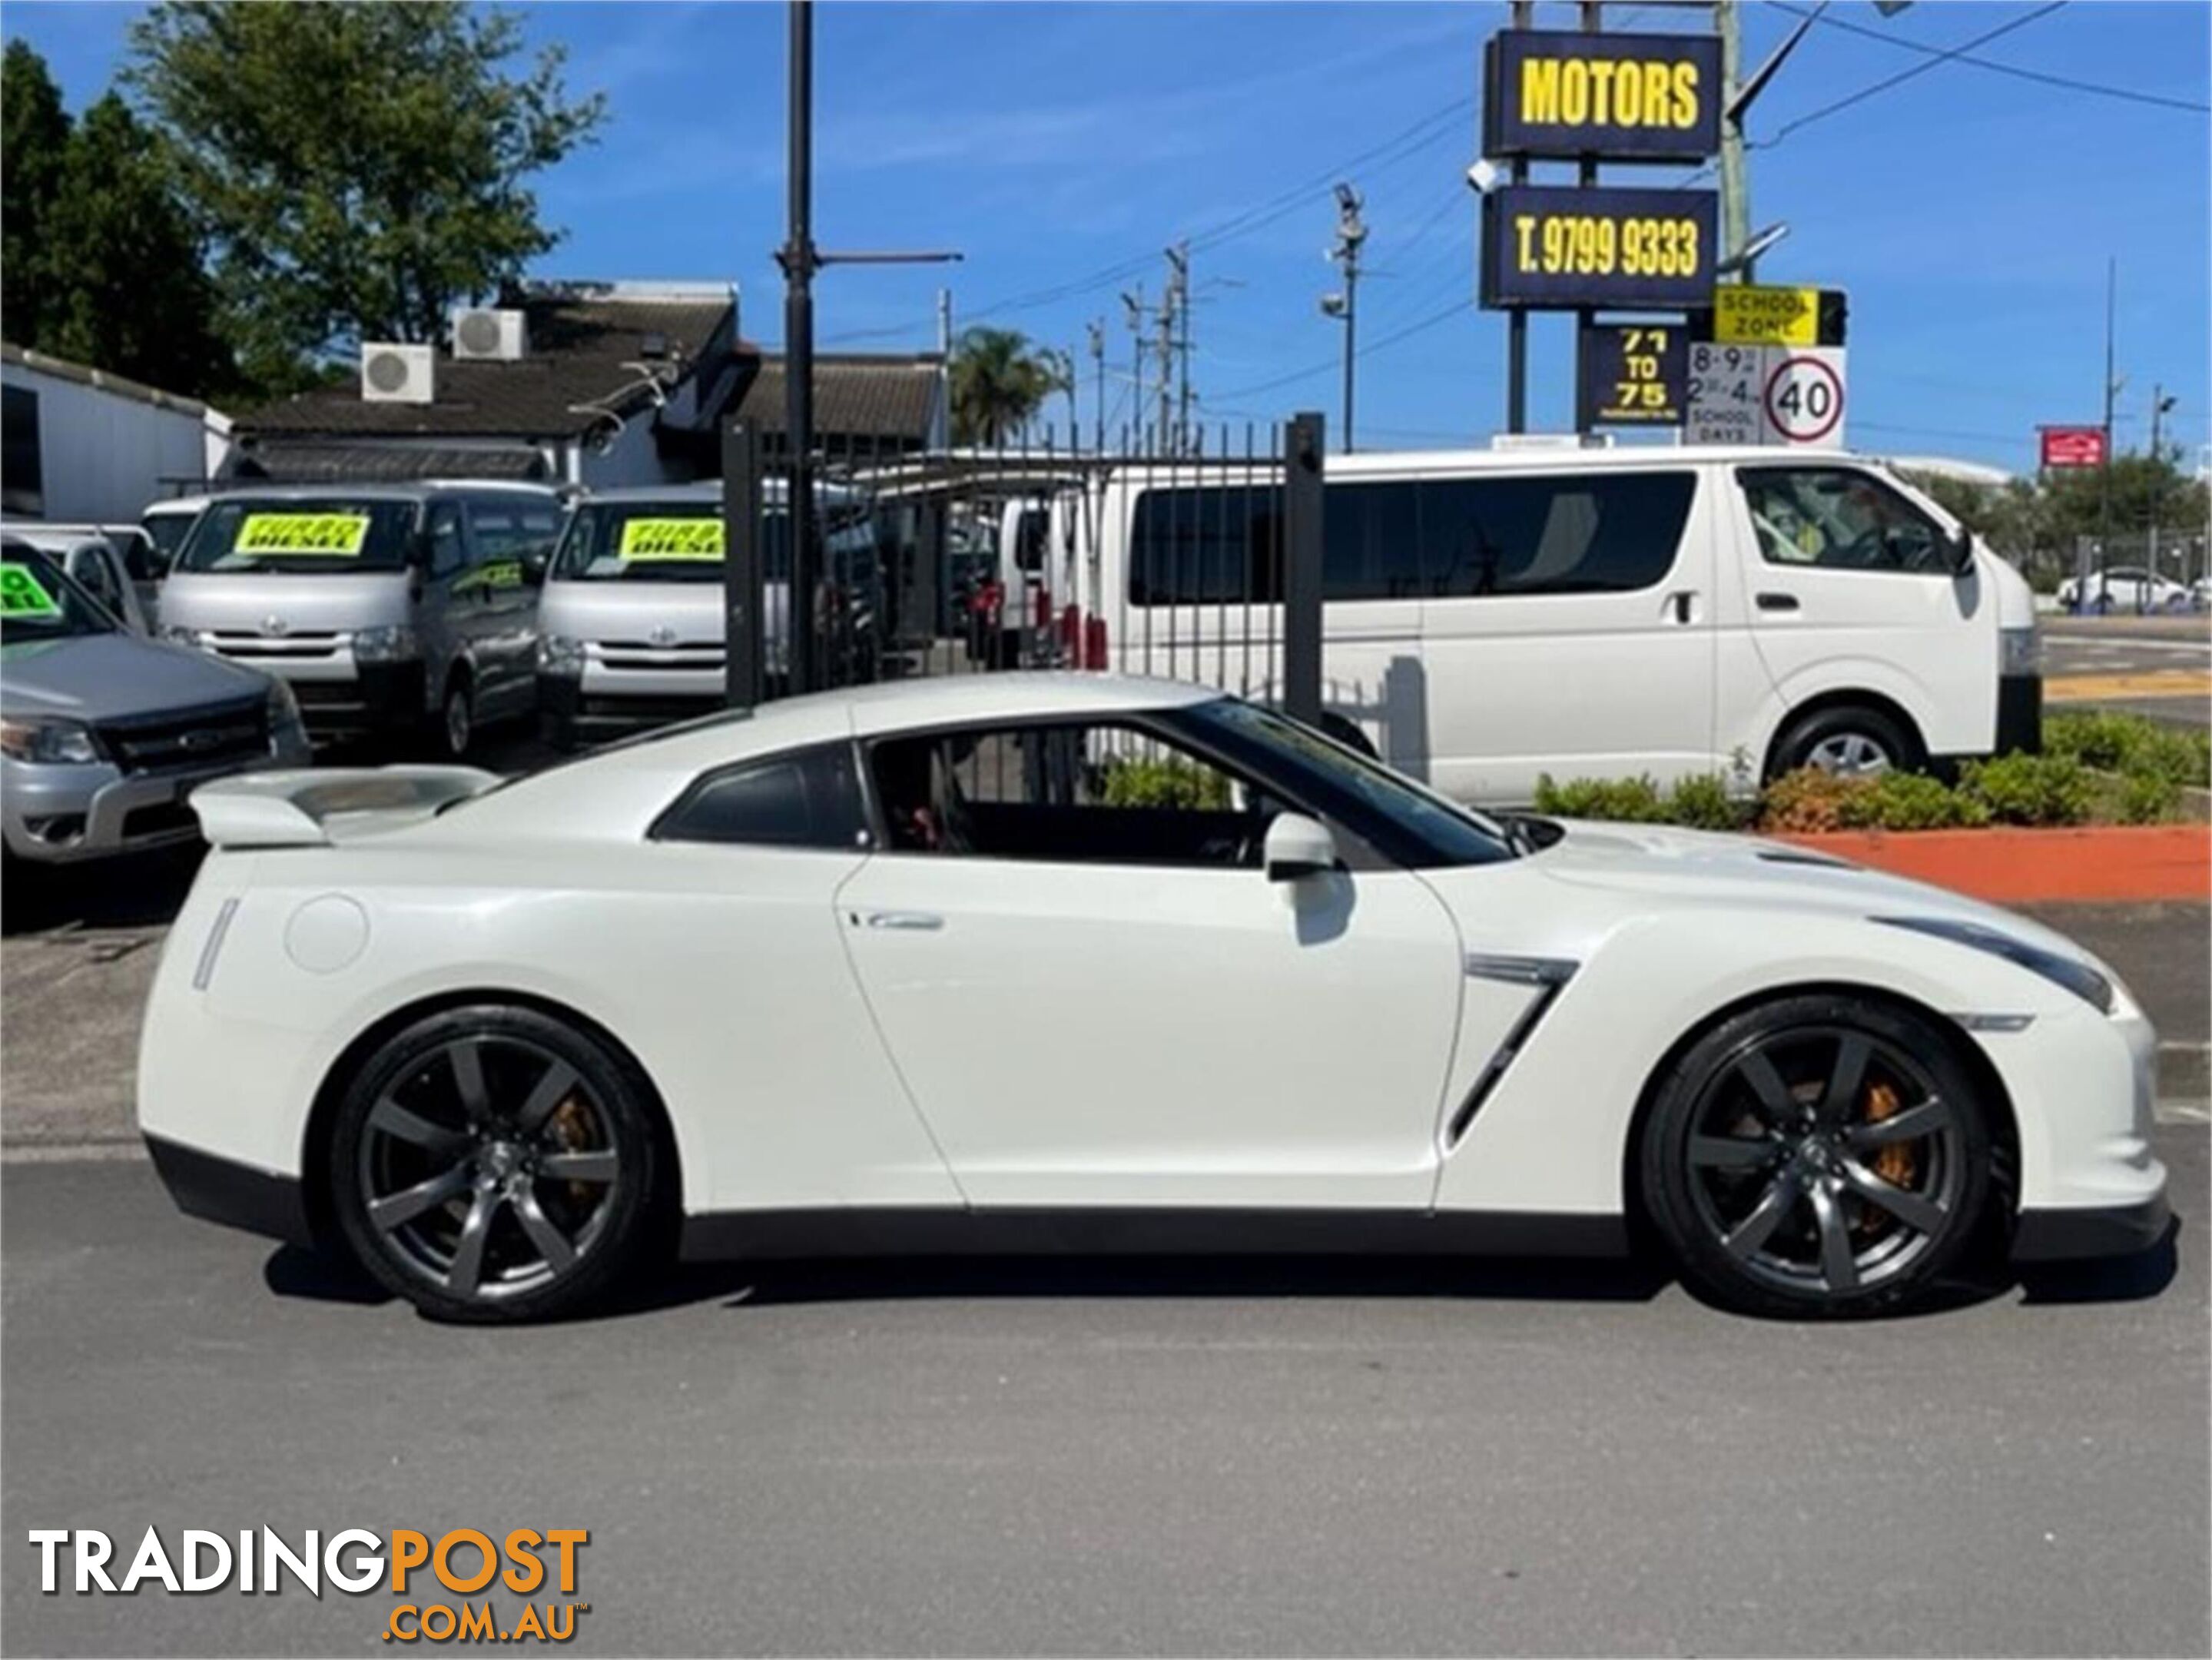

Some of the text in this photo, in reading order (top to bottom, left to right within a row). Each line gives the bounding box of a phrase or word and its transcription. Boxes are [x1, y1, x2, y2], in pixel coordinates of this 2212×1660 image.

[1521, 58, 1699, 128] MOTORS
[1543, 216, 1615, 274] 9799
[1622, 218, 1699, 276] 9333
[1723, 293, 1809, 314] SCHOOL
[1736, 317, 1794, 336] ZONE
[1620, 328, 1667, 353] 71
[1627, 356, 1658, 380] TO
[1617, 383, 1666, 407] 75
[1778, 382, 1831, 418] 40
